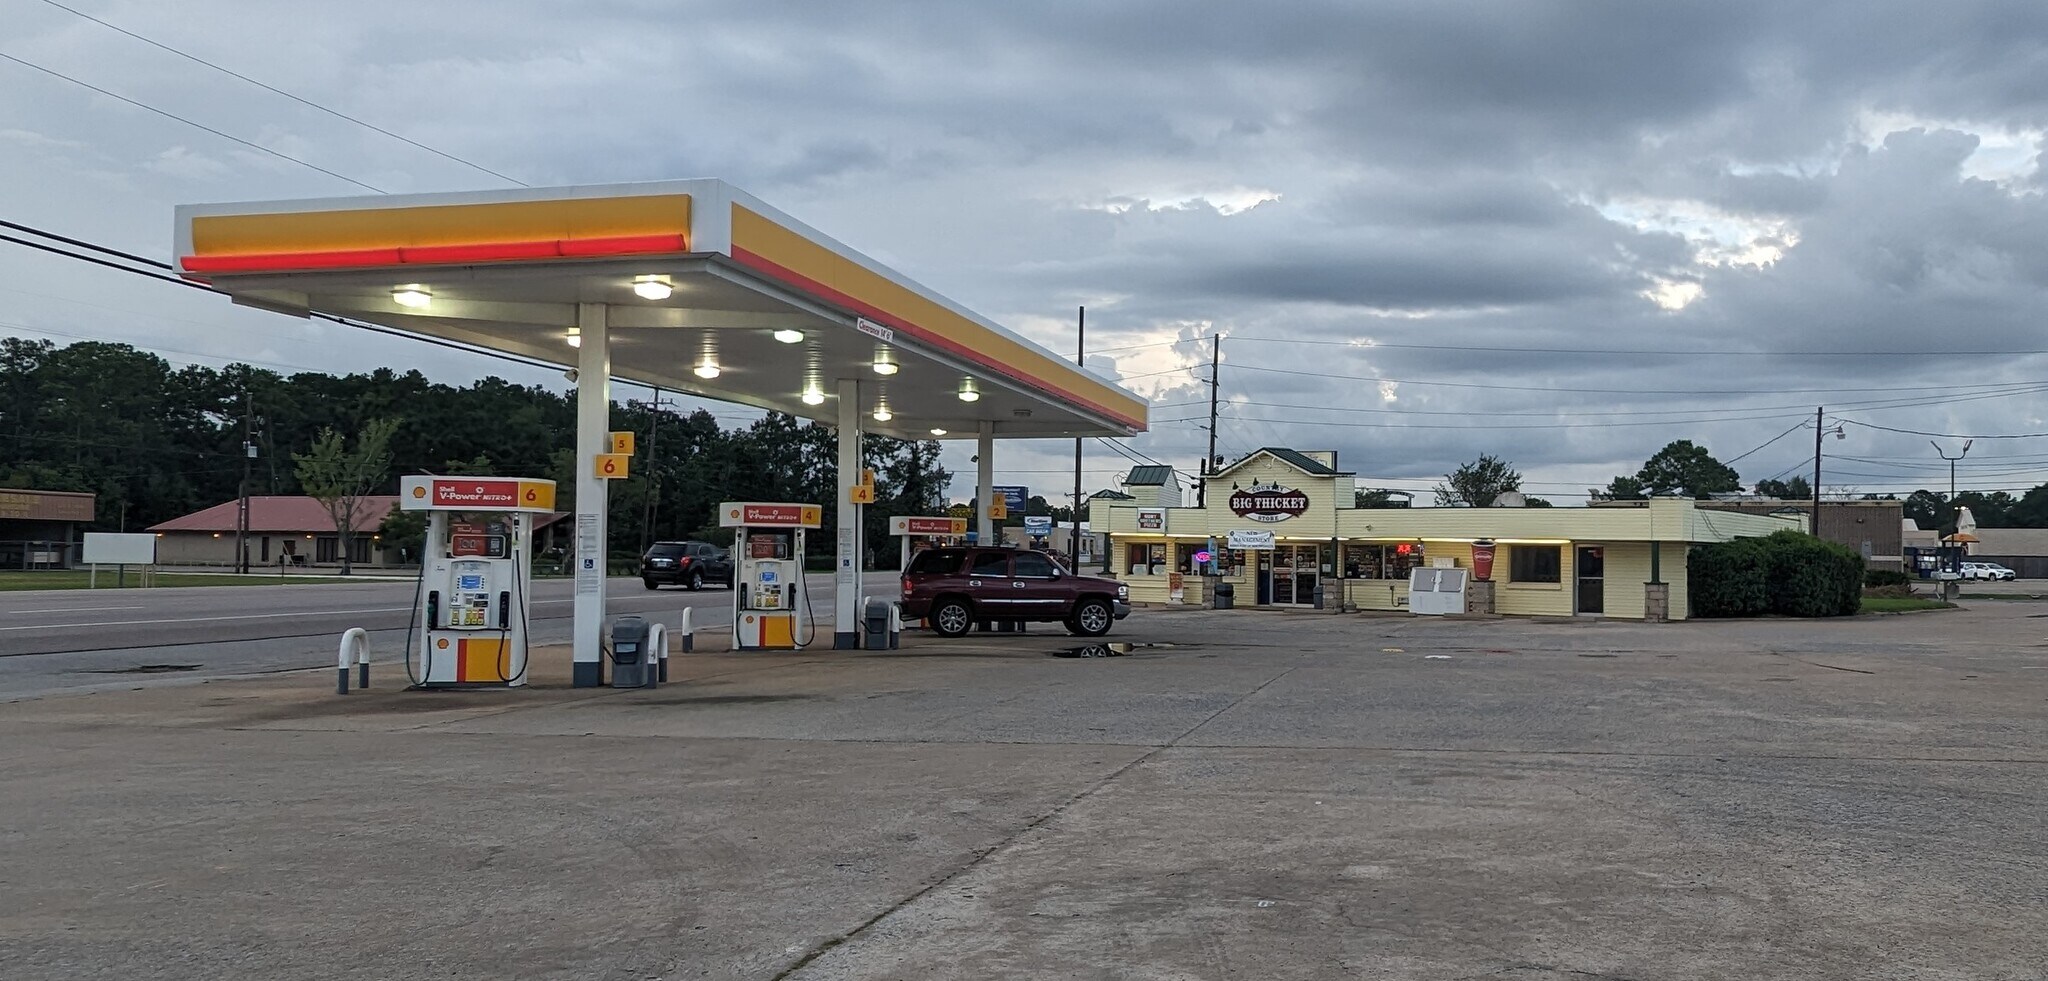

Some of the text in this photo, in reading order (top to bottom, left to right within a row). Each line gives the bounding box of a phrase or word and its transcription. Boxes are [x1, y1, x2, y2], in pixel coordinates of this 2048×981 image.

[859, 321, 880, 335] Clearance
[618, 439, 625, 449] 5
[603, 459, 616, 474] 6
[440, 491, 482, 500] V-Power
[526, 488, 537, 502] 6
[858, 489, 867, 500] 4
[1232, 497, 1306, 509] BIG THICKET
[805, 511, 813, 520] 4
[993, 507, 1001, 517] 2
[955, 522, 961, 531] 2
